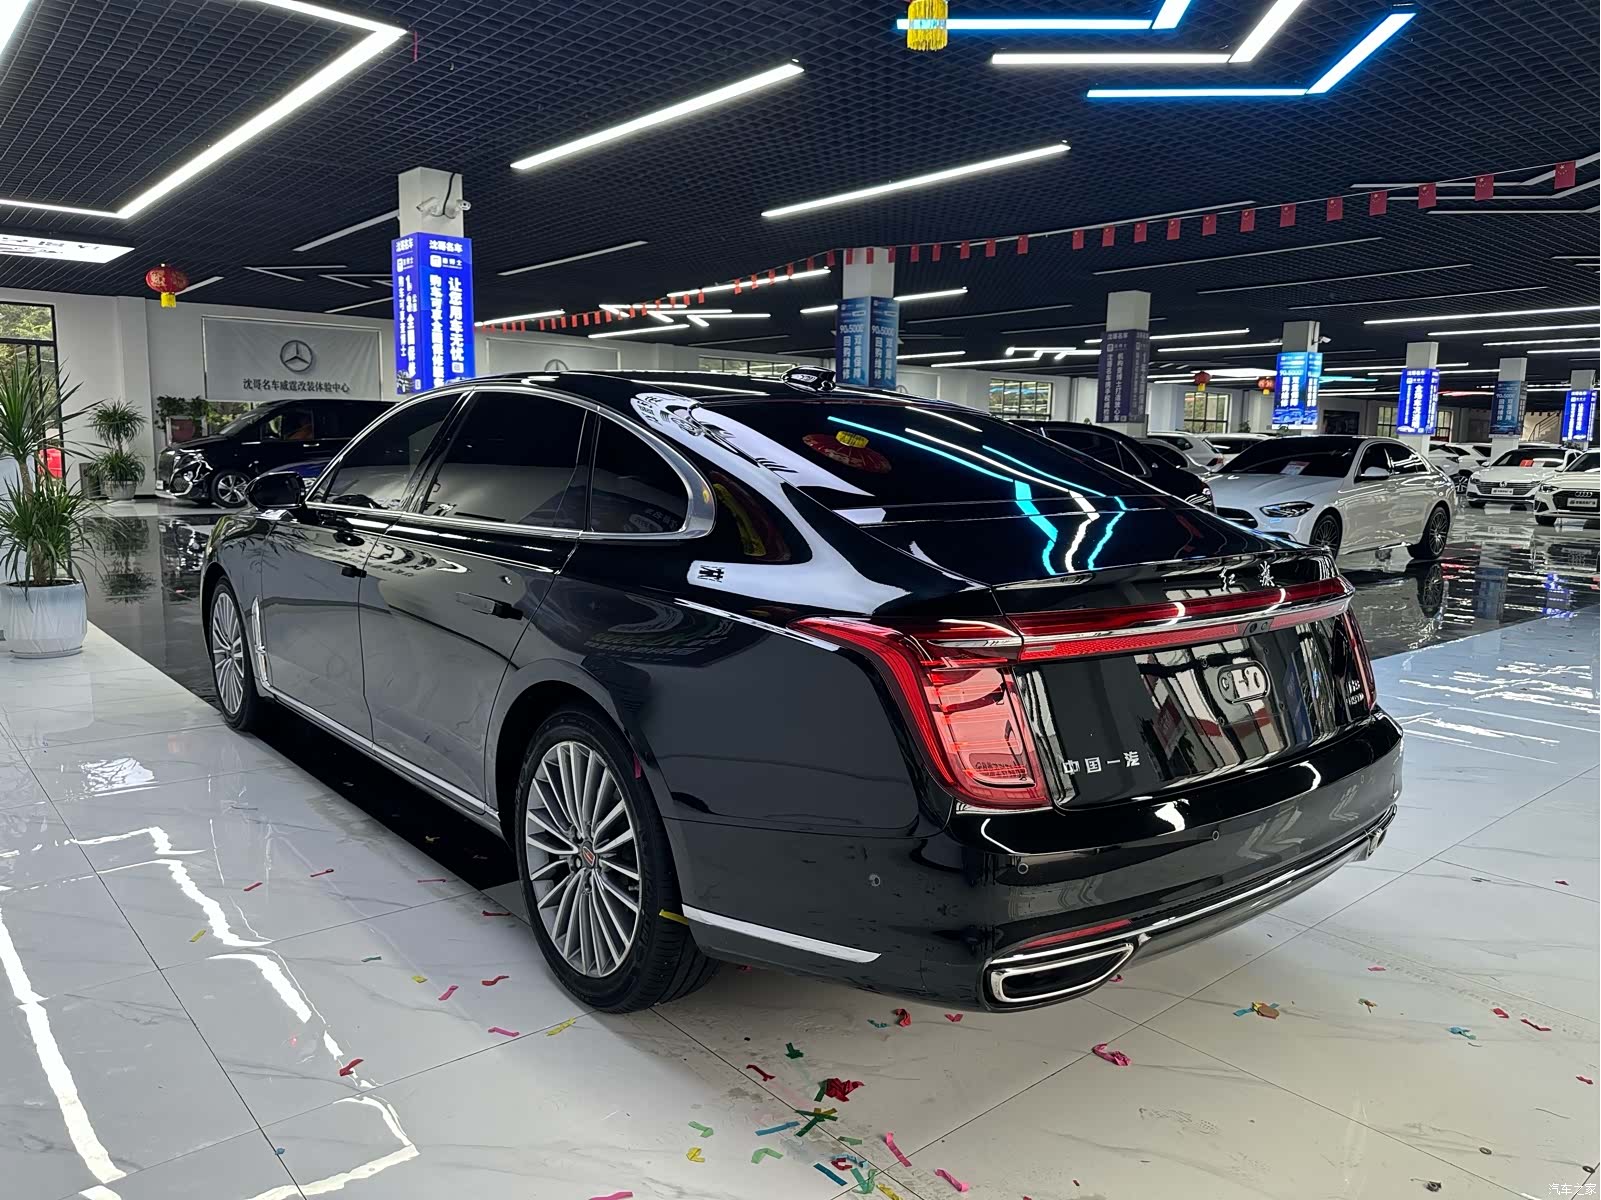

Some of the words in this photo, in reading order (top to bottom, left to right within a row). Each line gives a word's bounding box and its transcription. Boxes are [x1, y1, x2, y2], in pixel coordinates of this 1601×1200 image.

[429, 240, 463, 253] 沈哥名车
[243, 378, 350, 393] 沈哥名车威霆改装体验中心
[1063, 751, 1140, 776] 中国一汽
